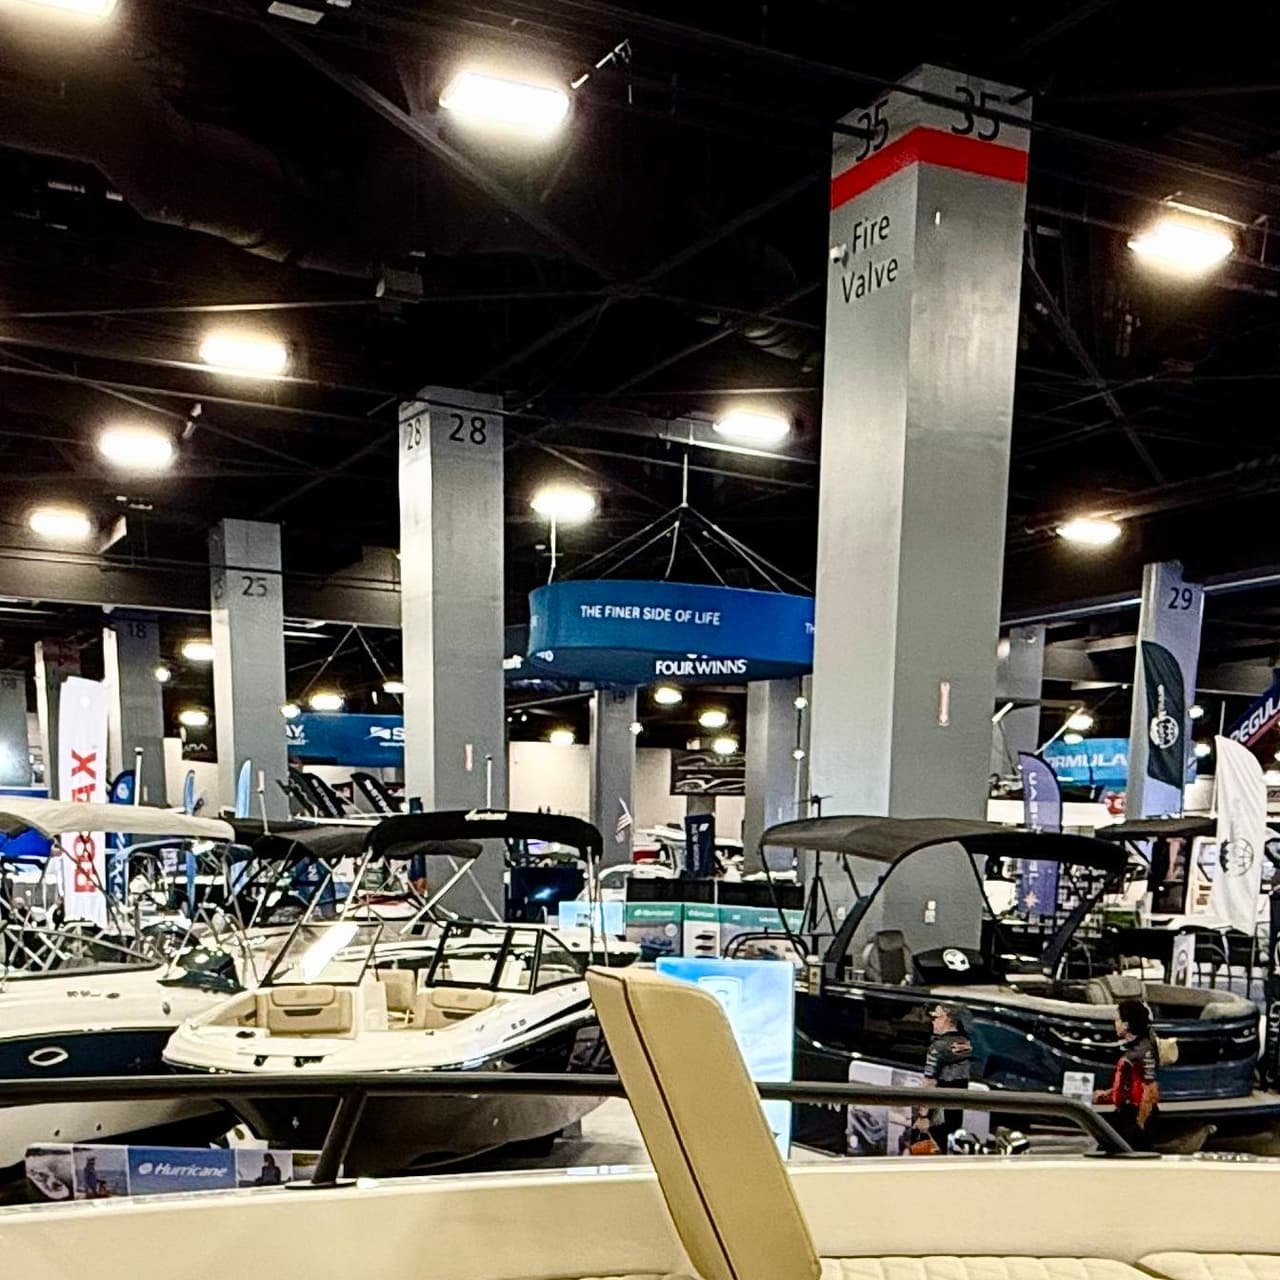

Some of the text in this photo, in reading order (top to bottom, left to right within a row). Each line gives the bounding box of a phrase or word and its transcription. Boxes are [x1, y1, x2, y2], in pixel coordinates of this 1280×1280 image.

[951, 86, 1001, 141] 35
[855, 99, 889, 162] 35
[852, 214, 891, 254] Fire
[841, 257, 899, 304] Valve
[448, 413, 487, 445] 28
[241, 575, 268, 598] 25
[1168, 586, 1193, 611] 29
[580, 604, 721, 626] THE FINER SIDE OF LIFE
[654, 658, 748, 676] FOUR WINNS
[1047, 752, 1128, 769] ORMULA
[153, 1161, 228, 1179] Hurricane
